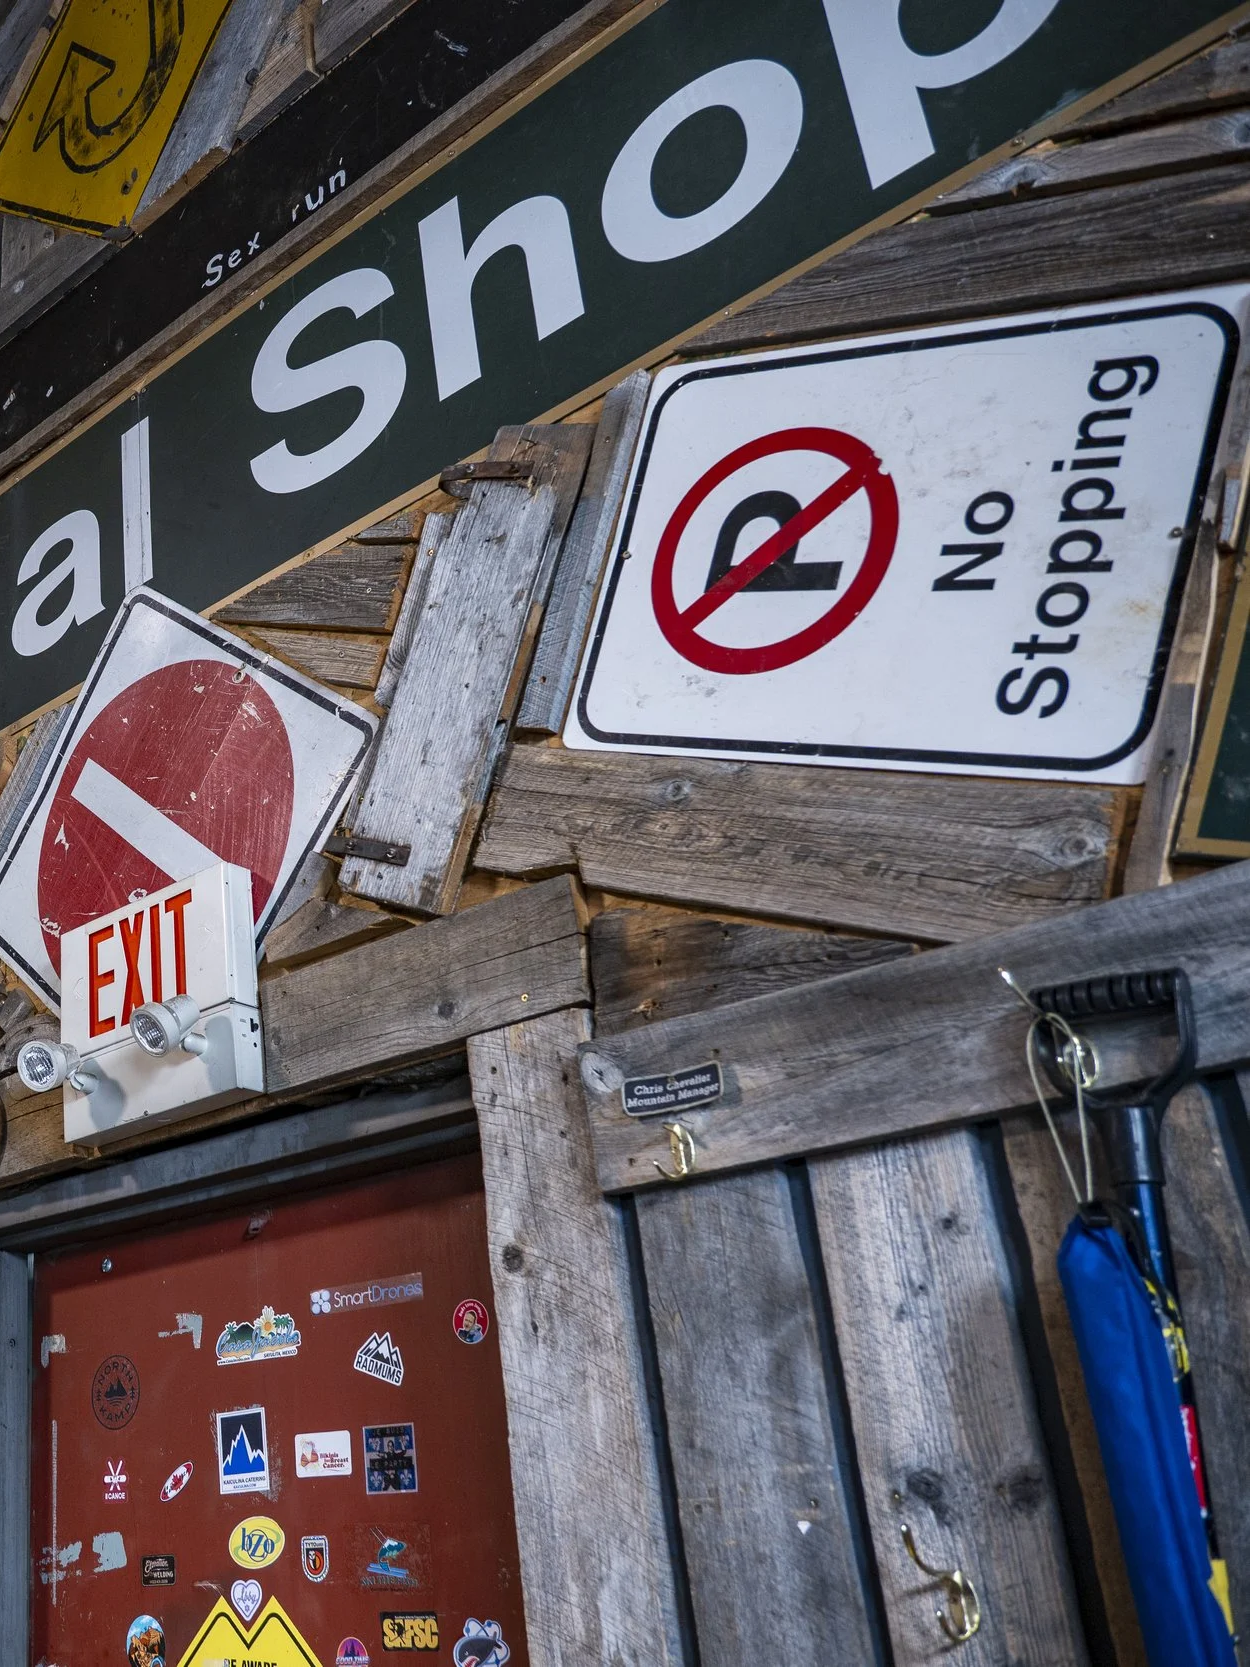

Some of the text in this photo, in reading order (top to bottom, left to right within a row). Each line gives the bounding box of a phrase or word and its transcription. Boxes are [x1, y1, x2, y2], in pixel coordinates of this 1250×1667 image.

[201, 230, 261, 289] Sex
[250, 0, 1054, 494] Shop
[933, 490, 1015, 593] No
[996, 353, 1159, 719] Stopping
[88, 888, 193, 1039] EXIT
[626, 1083, 720, 1108] Mountain Manager
[634, 1073, 712, 1096] Chris Chevalier
[333, 1280, 424, 1309] SmartDrones
[97, 1361, 134, 1386] NORTH
[355, 1354, 402, 1385] RADMUMS
[99, 1402, 132, 1422] KAMP
